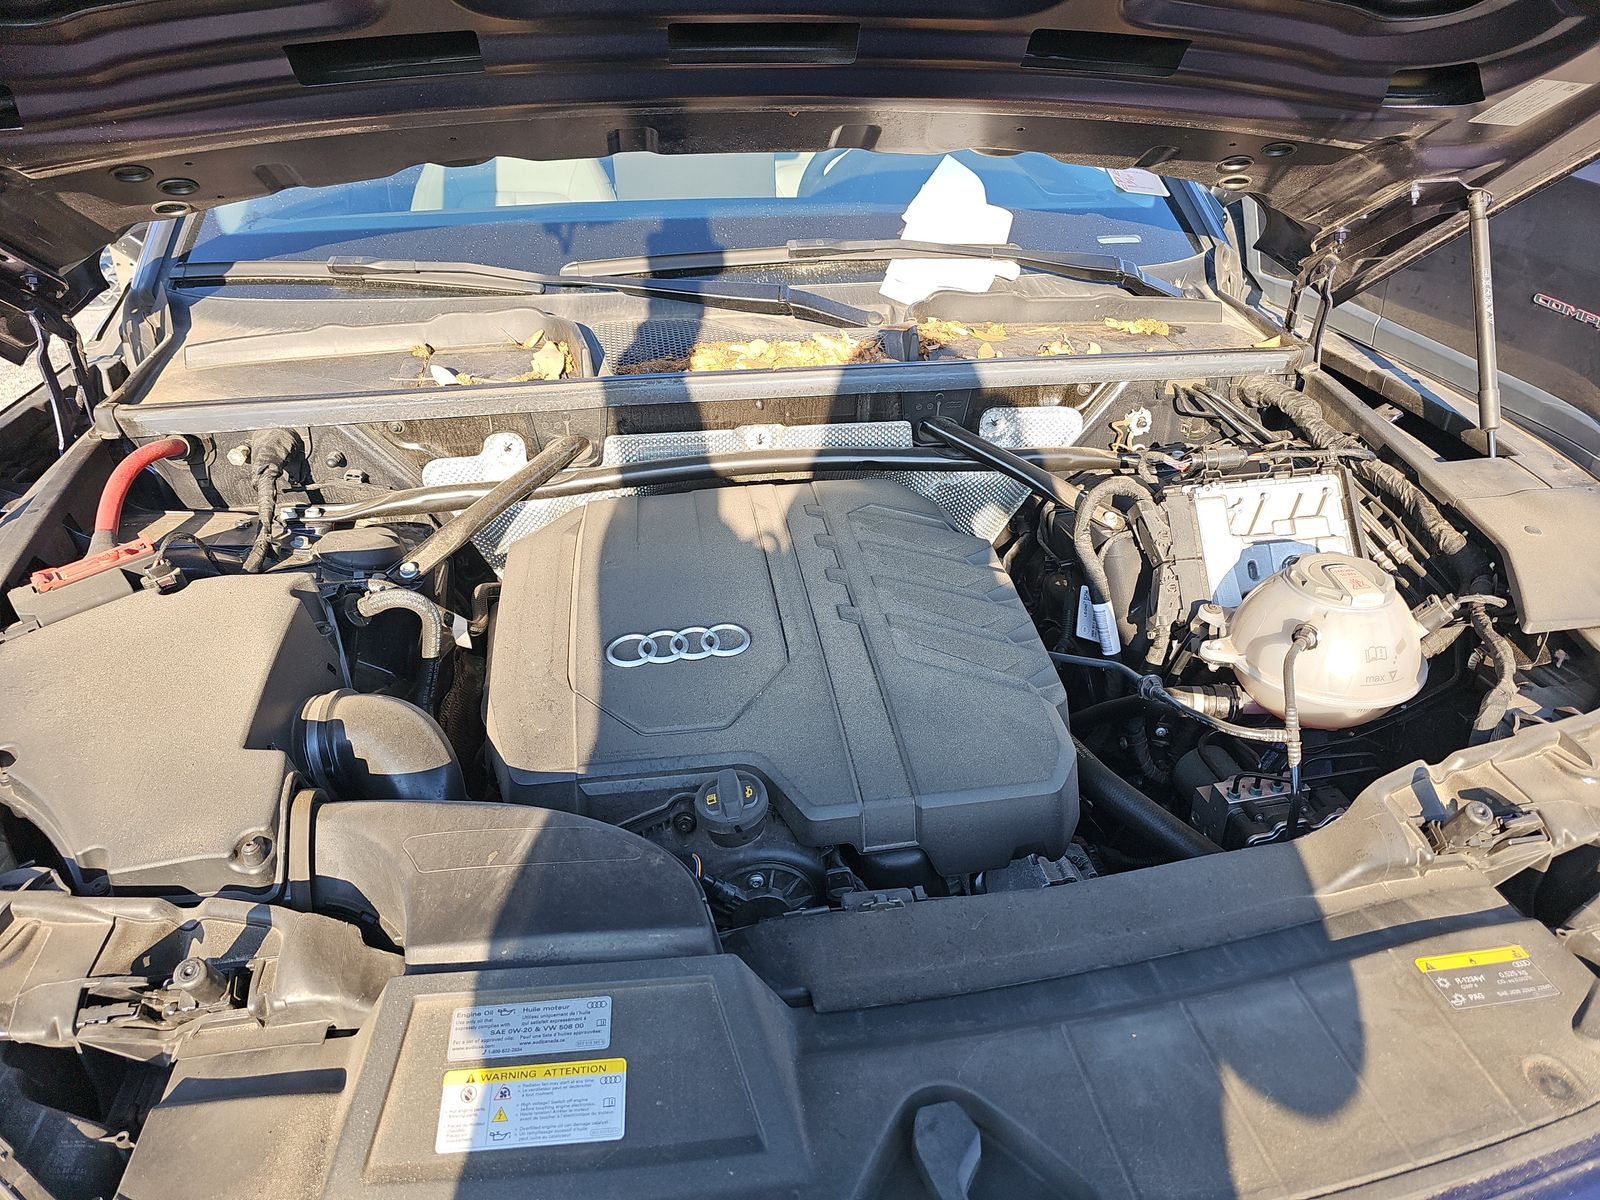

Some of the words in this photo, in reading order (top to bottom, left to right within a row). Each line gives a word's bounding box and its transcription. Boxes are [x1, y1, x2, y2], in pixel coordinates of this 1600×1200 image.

[1533, 292, 1600, 330] COMP
[1366, 675, 1385, 683] max
[456, 1010, 482, 1018] Engine
[507, 1026, 532, 1034] 0W-20
[480, 1070, 537, 1082] WARNING
[543, 1064, 607, 1077] ATTENTION
